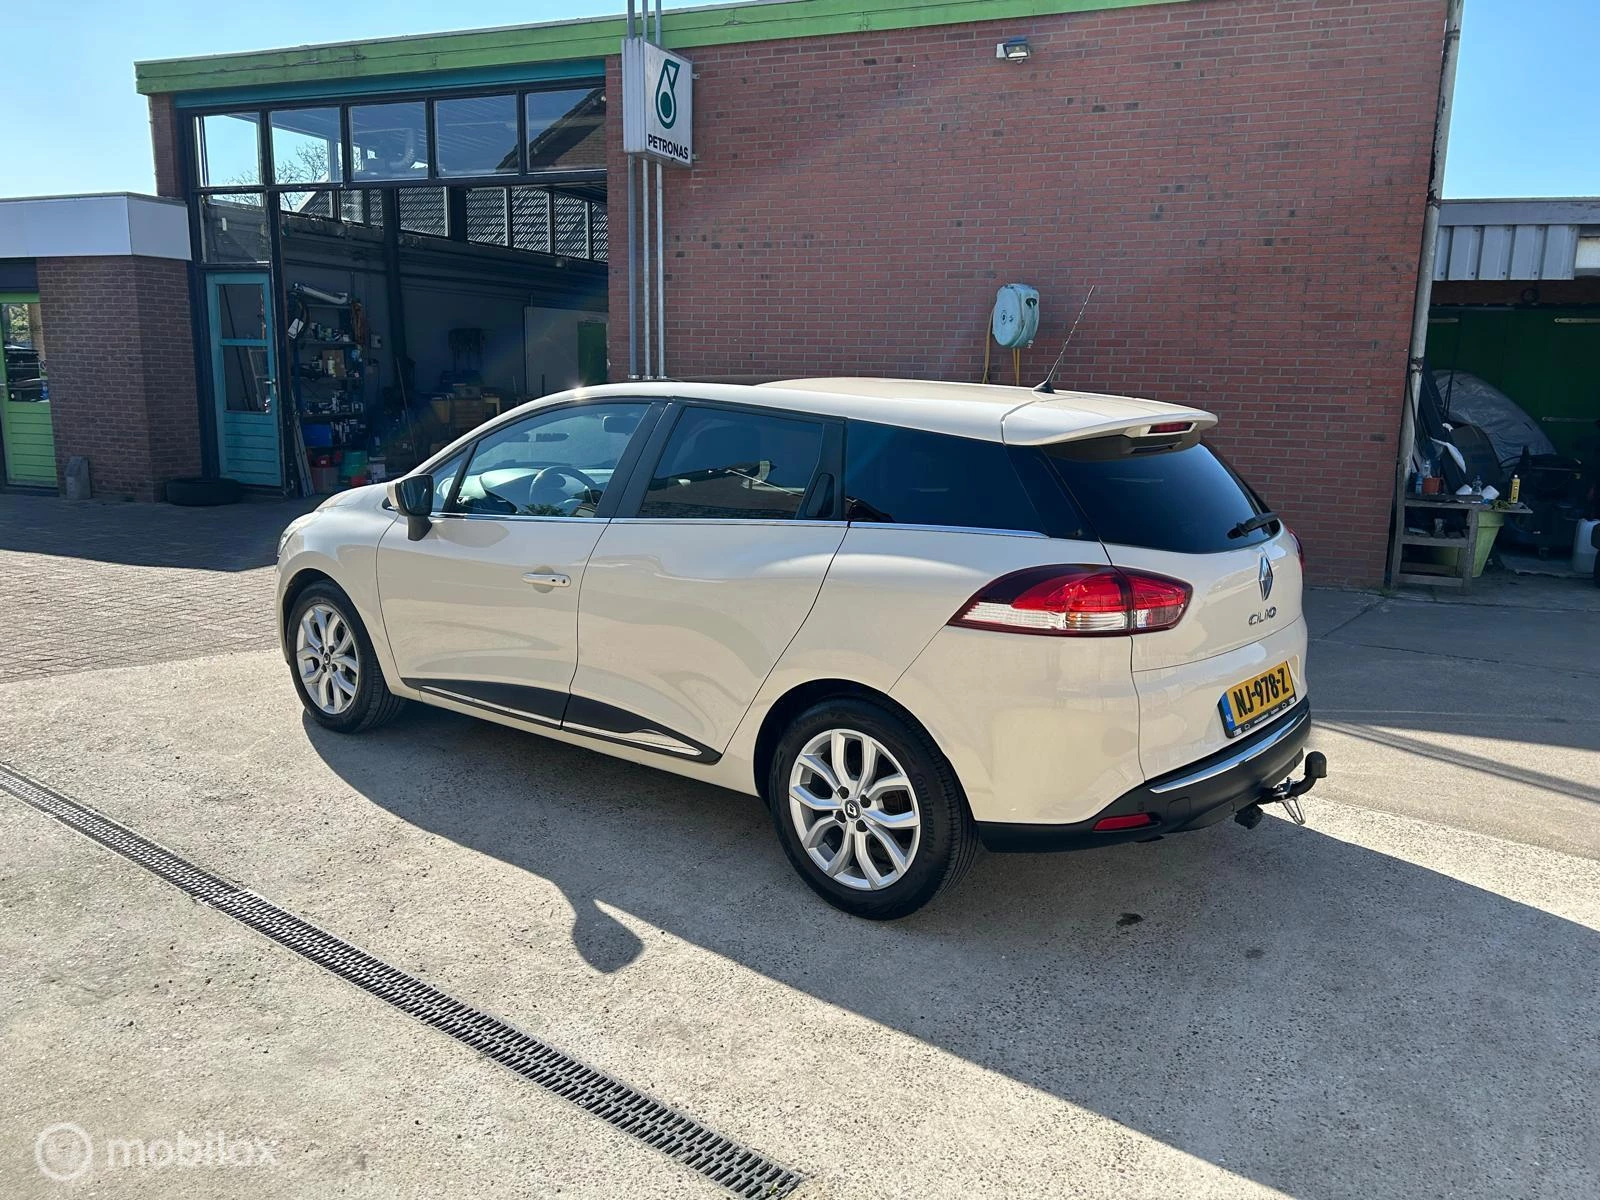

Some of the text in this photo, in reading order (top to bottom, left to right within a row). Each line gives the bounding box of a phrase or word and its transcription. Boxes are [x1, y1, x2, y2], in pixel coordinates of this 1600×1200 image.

[648, 134, 689, 160] PETRONAS
[1248, 606, 1277, 626] CLIO
[1233, 667, 1290, 719] NJ-978-Z
